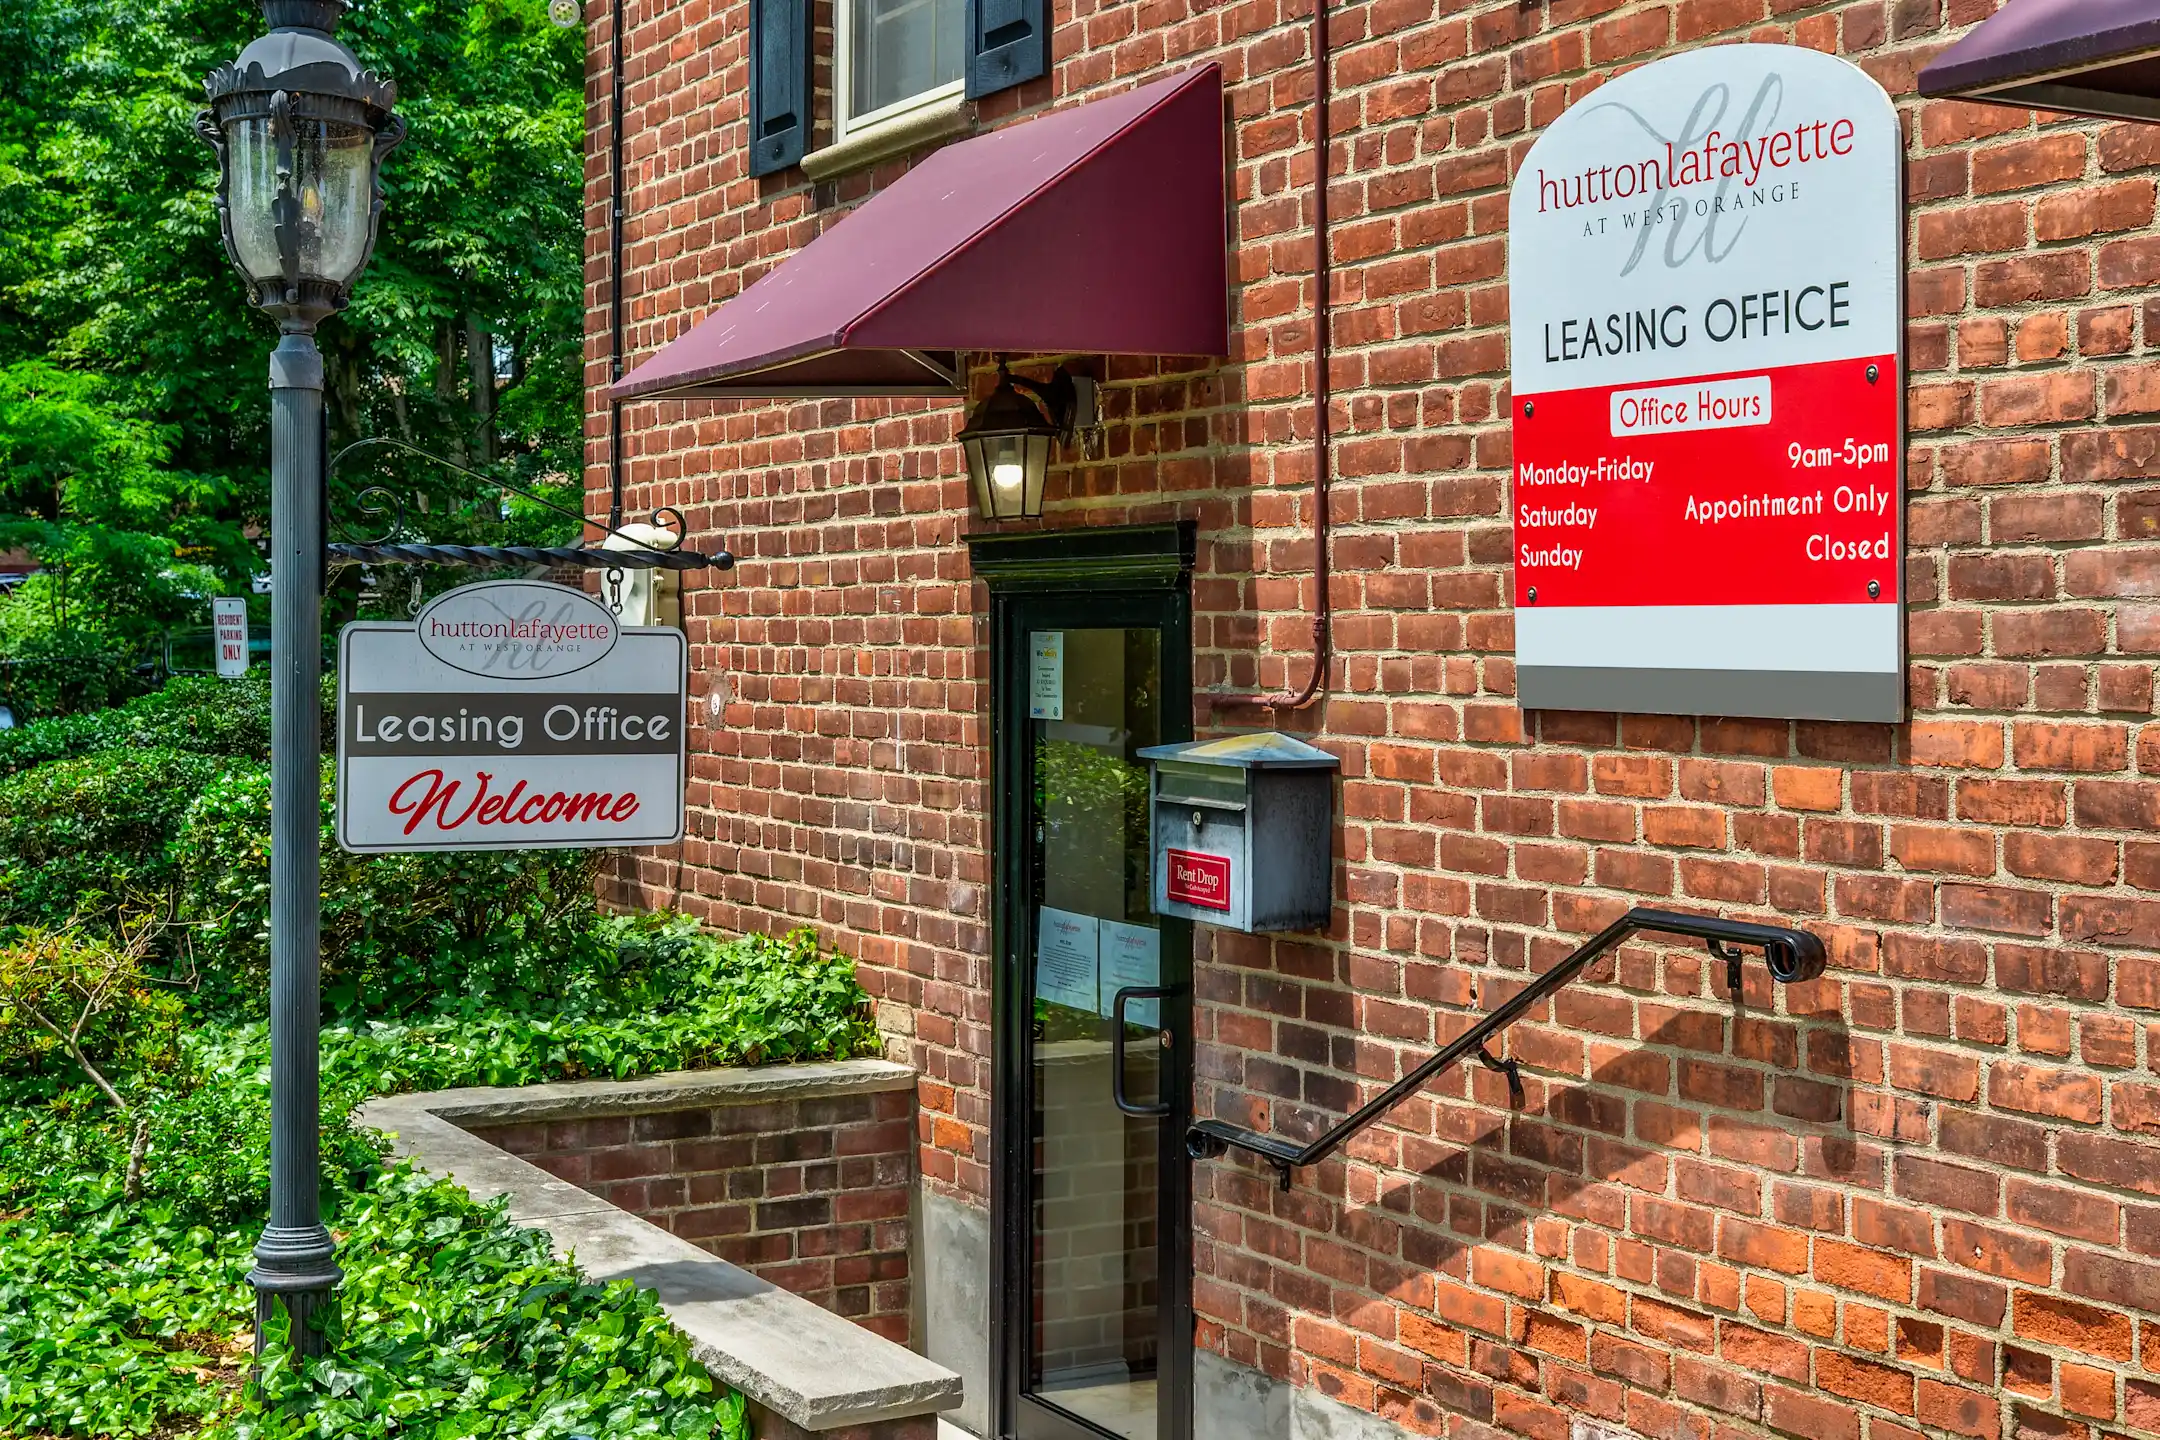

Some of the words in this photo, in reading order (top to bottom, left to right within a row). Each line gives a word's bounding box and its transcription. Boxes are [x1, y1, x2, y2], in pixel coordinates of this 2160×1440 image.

[1538, 118, 1854, 213] huttonlafayette
[1583, 217, 1608, 238] AT
[1623, 204, 1680, 230] WEST
[1695, 181, 1801, 216] ORANGE
[1545, 304, 1688, 363] LEASING
[1704, 281, 1850, 342] OFFICE
[1620, 396, 1688, 428] Office
[1699, 391, 1761, 422] Hours
[1788, 438, 1889, 470] 9am-5pm
[1519, 456, 1655, 487] Monday-Friday
[1519, 503, 1598, 529] Saturday
[1684, 489, 1823, 524] Appointment
[1833, 484, 1889, 516] Only
[1520, 543, 1583, 570] Sunday
[1805, 532, 1889, 561] Closed
[217, 614, 243, 626] RESIDENT
[220, 629, 243, 641] PARKING
[430, 618, 609, 644] huttonlafayette
[223, 644, 241, 661] ONLY
[459, 643, 475, 652] AT
[483, 643, 518, 652] WEST
[525, 643, 582, 653] ORANGE
[356, 704, 524, 749] Leasing
[543, 704, 672, 742] Office
[388, 768, 640, 836] Welcome
[1177, 864, 1196, 883] Rent
[1197, 868, 1219, 892] Drop
